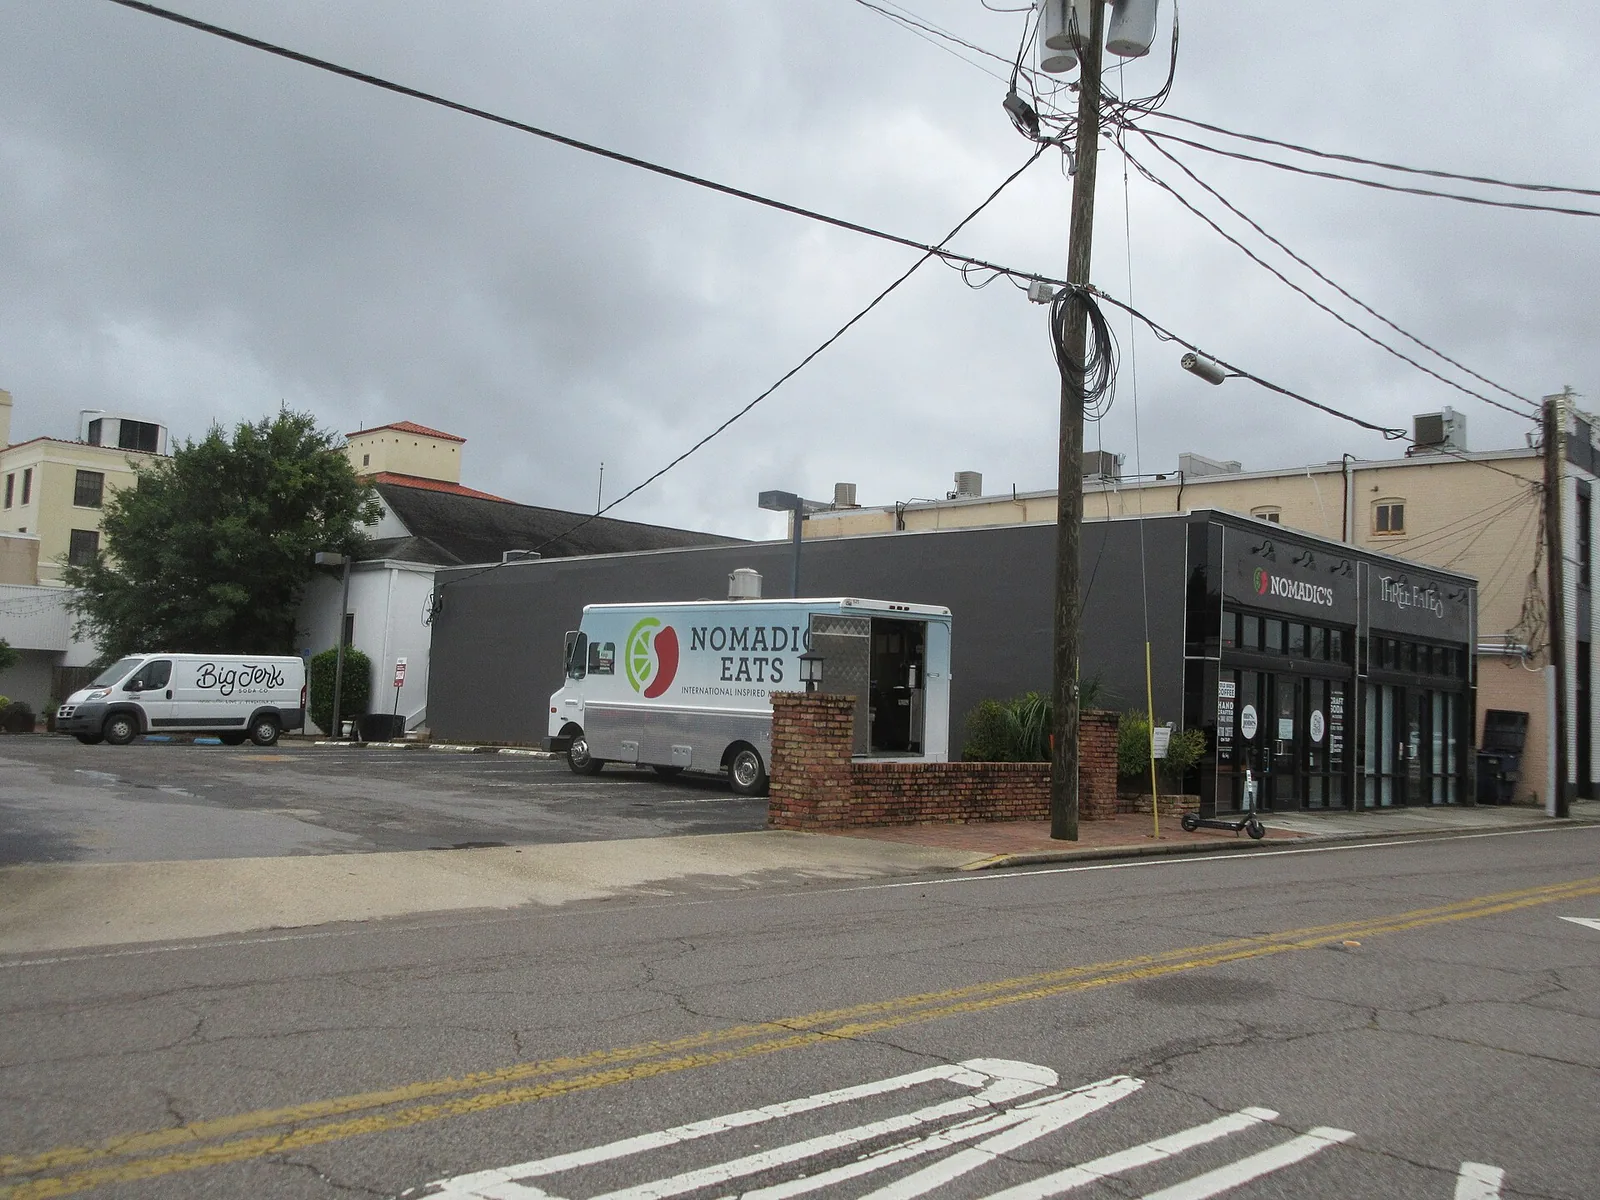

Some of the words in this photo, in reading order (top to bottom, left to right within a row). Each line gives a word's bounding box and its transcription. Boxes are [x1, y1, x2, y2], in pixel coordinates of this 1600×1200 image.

[1270, 576, 1333, 607] NOMADIC'S
[196, 662, 238, 697] Big
[238, 664, 285, 689] Jerk
[720, 656, 784, 684] EATS
[681, 686, 733, 697] INTERNATIONAL
[734, 688, 766, 698] INSPIRED
